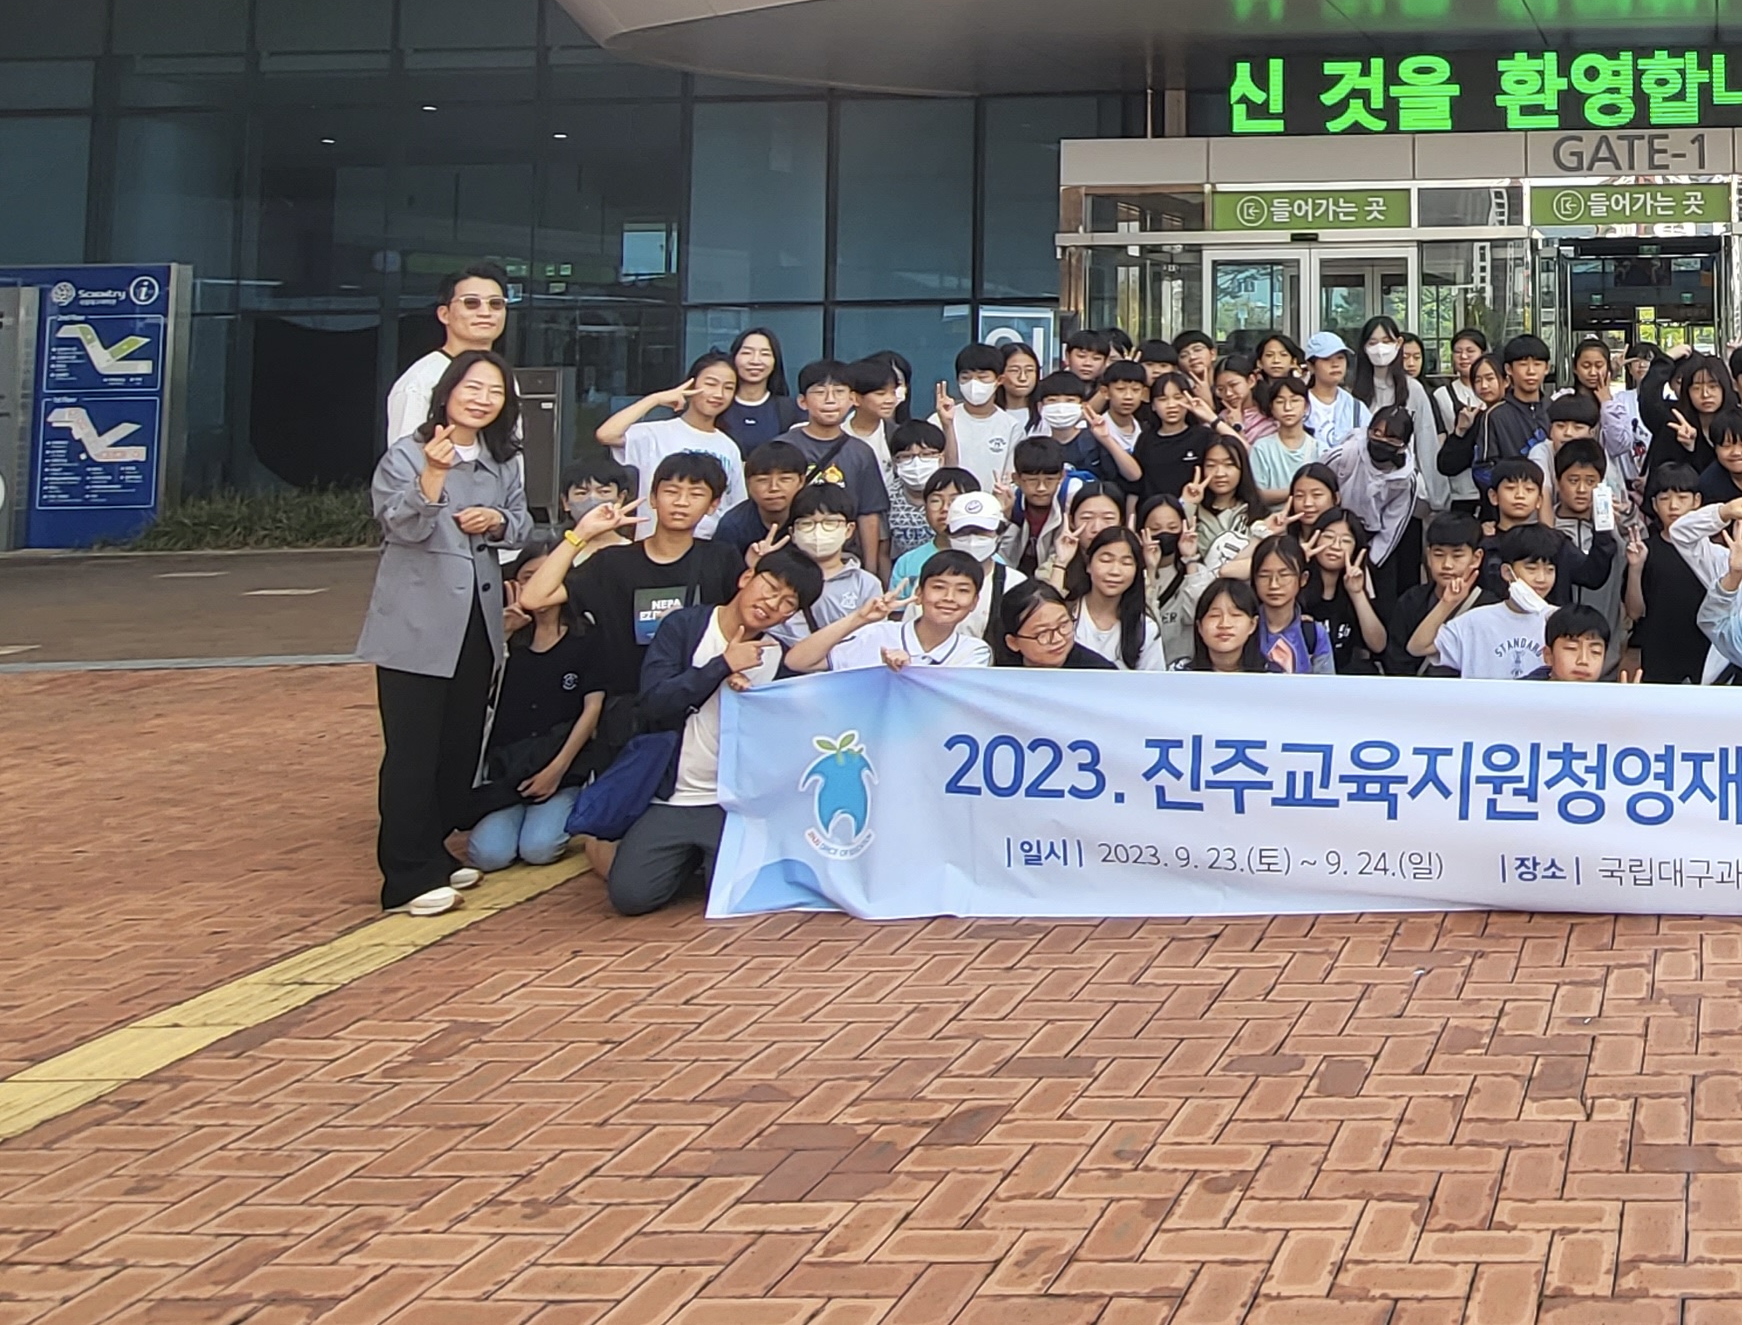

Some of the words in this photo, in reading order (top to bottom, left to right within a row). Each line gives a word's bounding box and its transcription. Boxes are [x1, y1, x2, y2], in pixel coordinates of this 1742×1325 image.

[1230, 58, 1285, 134] 신
[1319, 54, 1461, 133] 것을
[1551, 133, 1709, 173] GATE-1
[1270, 197, 1359, 223] 들어가는
[1364, 196, 1388, 222] 곳
[1586, 186, 1677, 217] 들어가는
[1682, 185, 1706, 217] 곳
[943, 733, 1126, 805] 2023.
